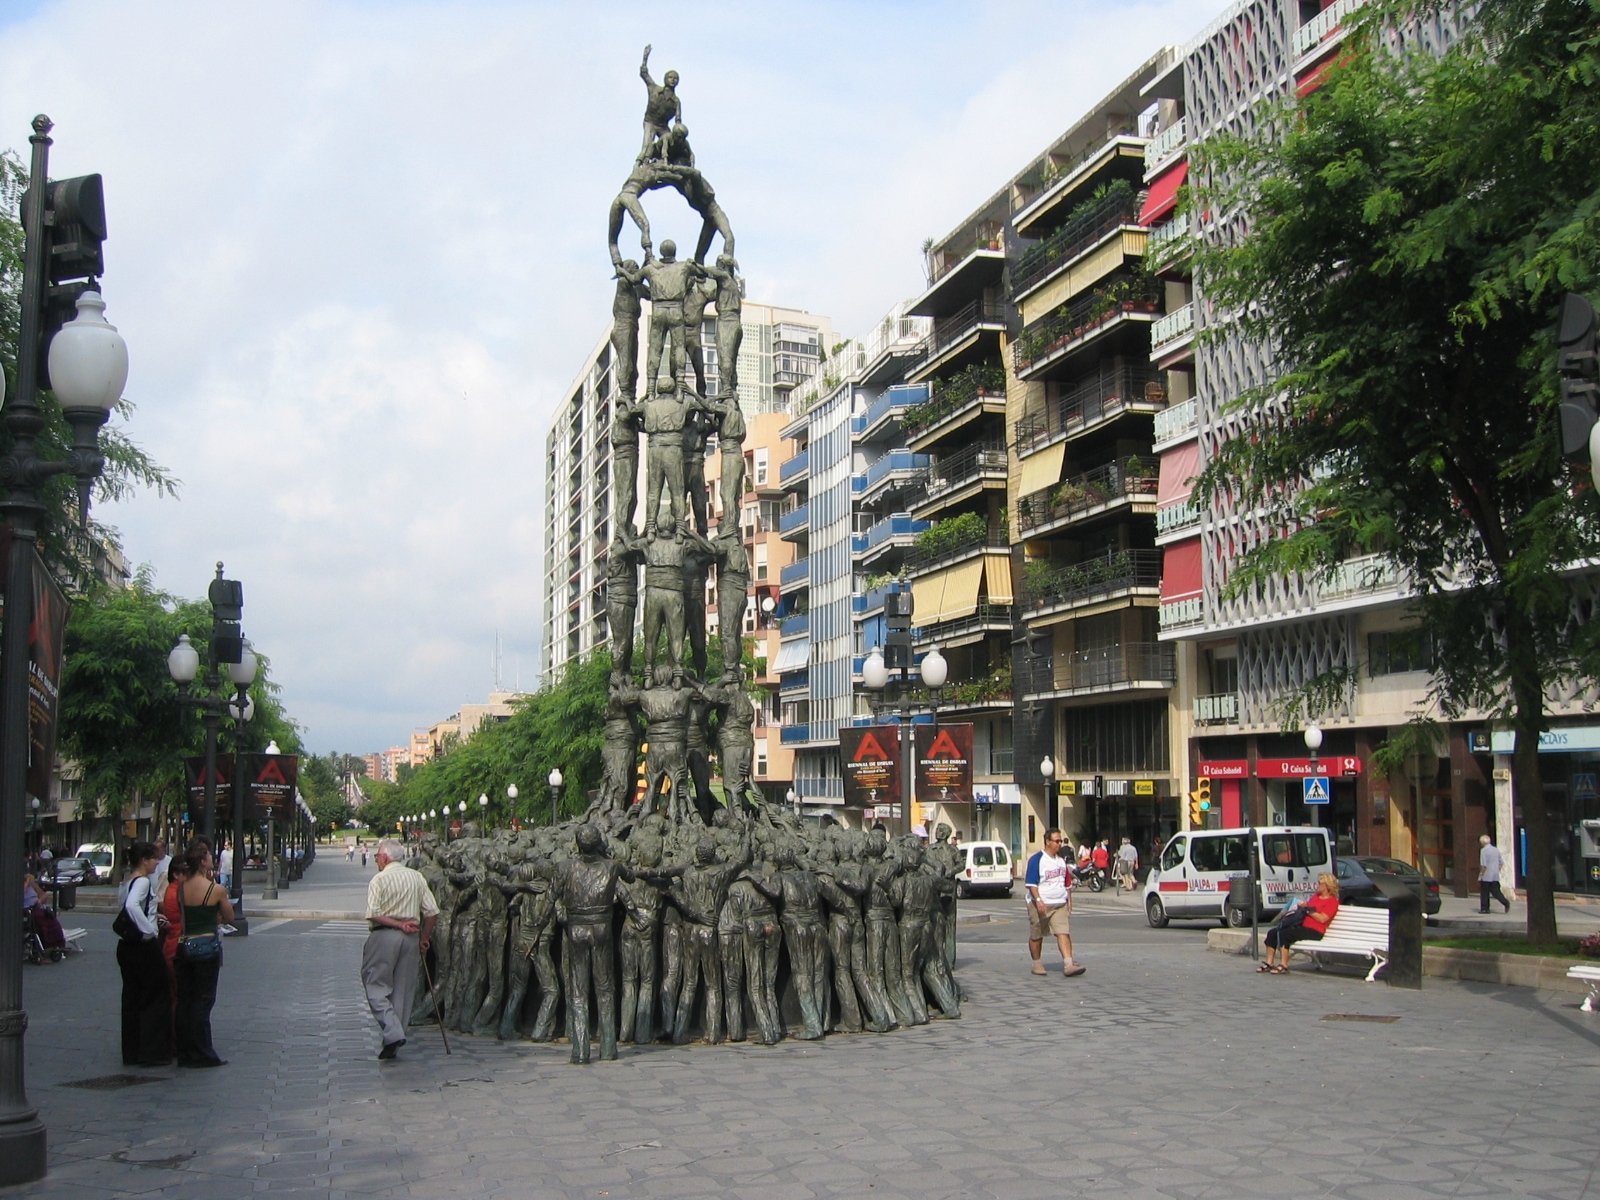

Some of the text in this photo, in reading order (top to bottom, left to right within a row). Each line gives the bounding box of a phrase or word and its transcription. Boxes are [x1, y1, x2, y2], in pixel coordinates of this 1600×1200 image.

[926, 729, 962, 759] A
[1539, 733, 1568, 745] RCLAYS
[853, 731, 889, 762] A
[1210, 766, 1242, 775] Caixa Sabadell
[1290, 764, 1327, 773] Caixa Sadell
[1266, 882, 1319, 892] WWW.LIALPA.C
